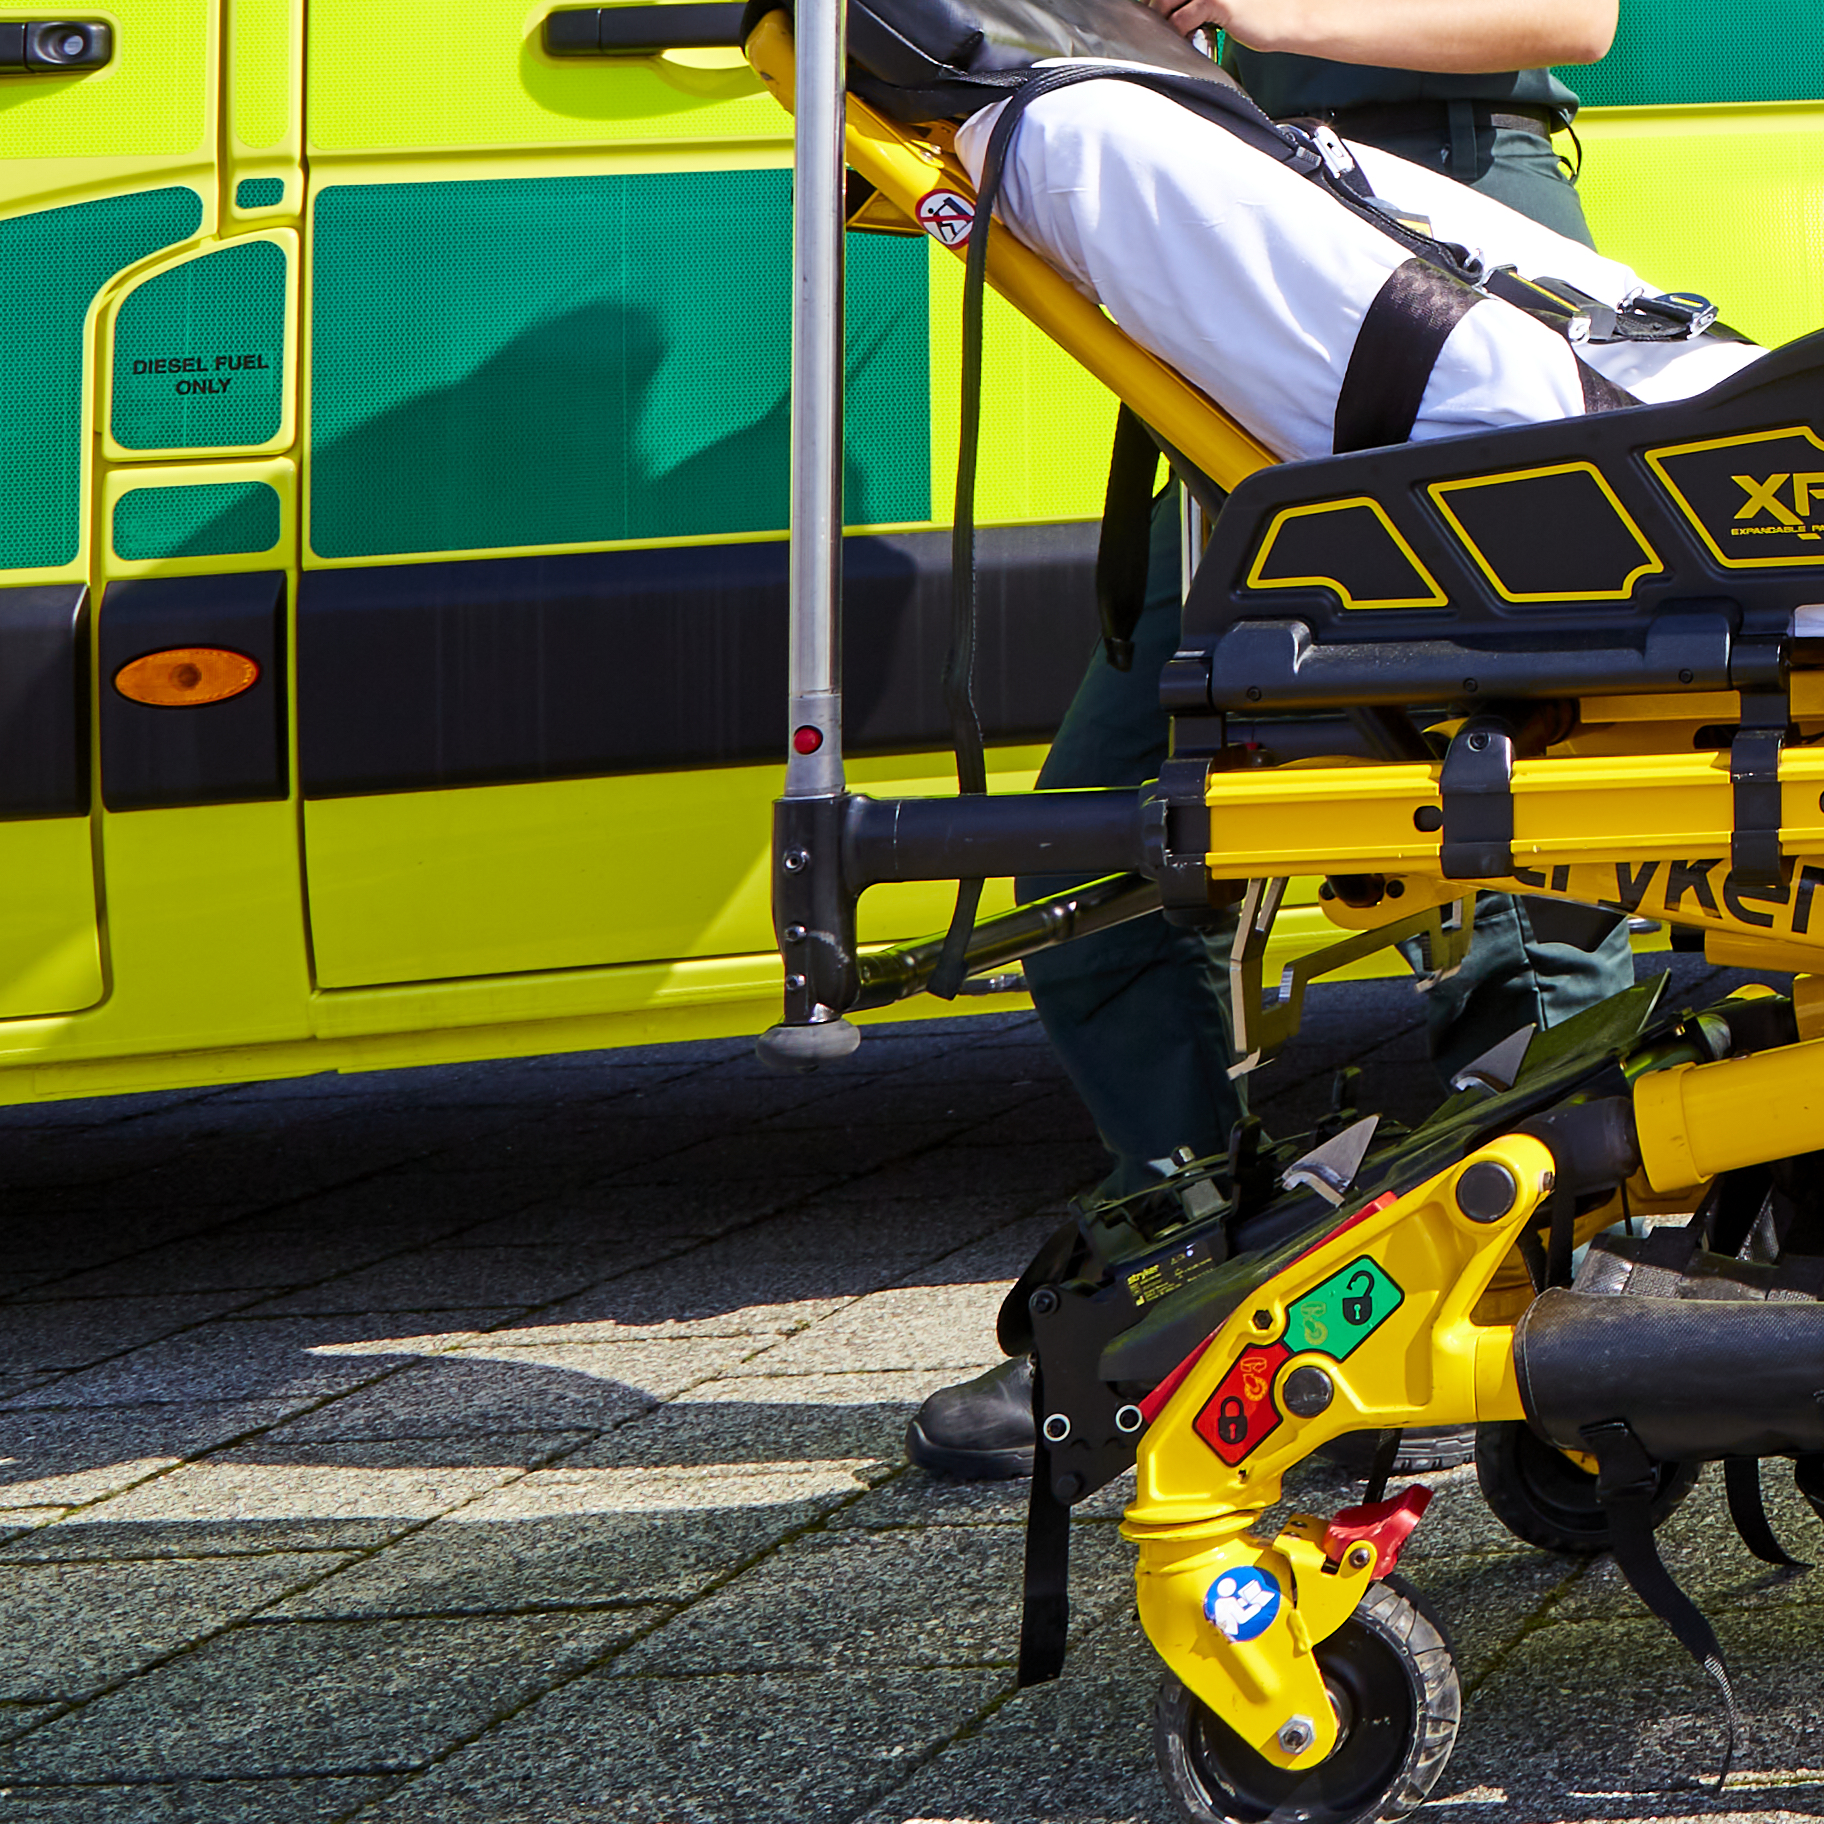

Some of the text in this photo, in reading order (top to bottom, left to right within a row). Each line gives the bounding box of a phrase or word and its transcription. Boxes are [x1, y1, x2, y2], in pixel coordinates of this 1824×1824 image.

[132, 354, 269, 375] DIESEL FUEL
[175, 377, 232, 395] ONLY
[1731, 525, 1807, 536] EXPANDABLE
